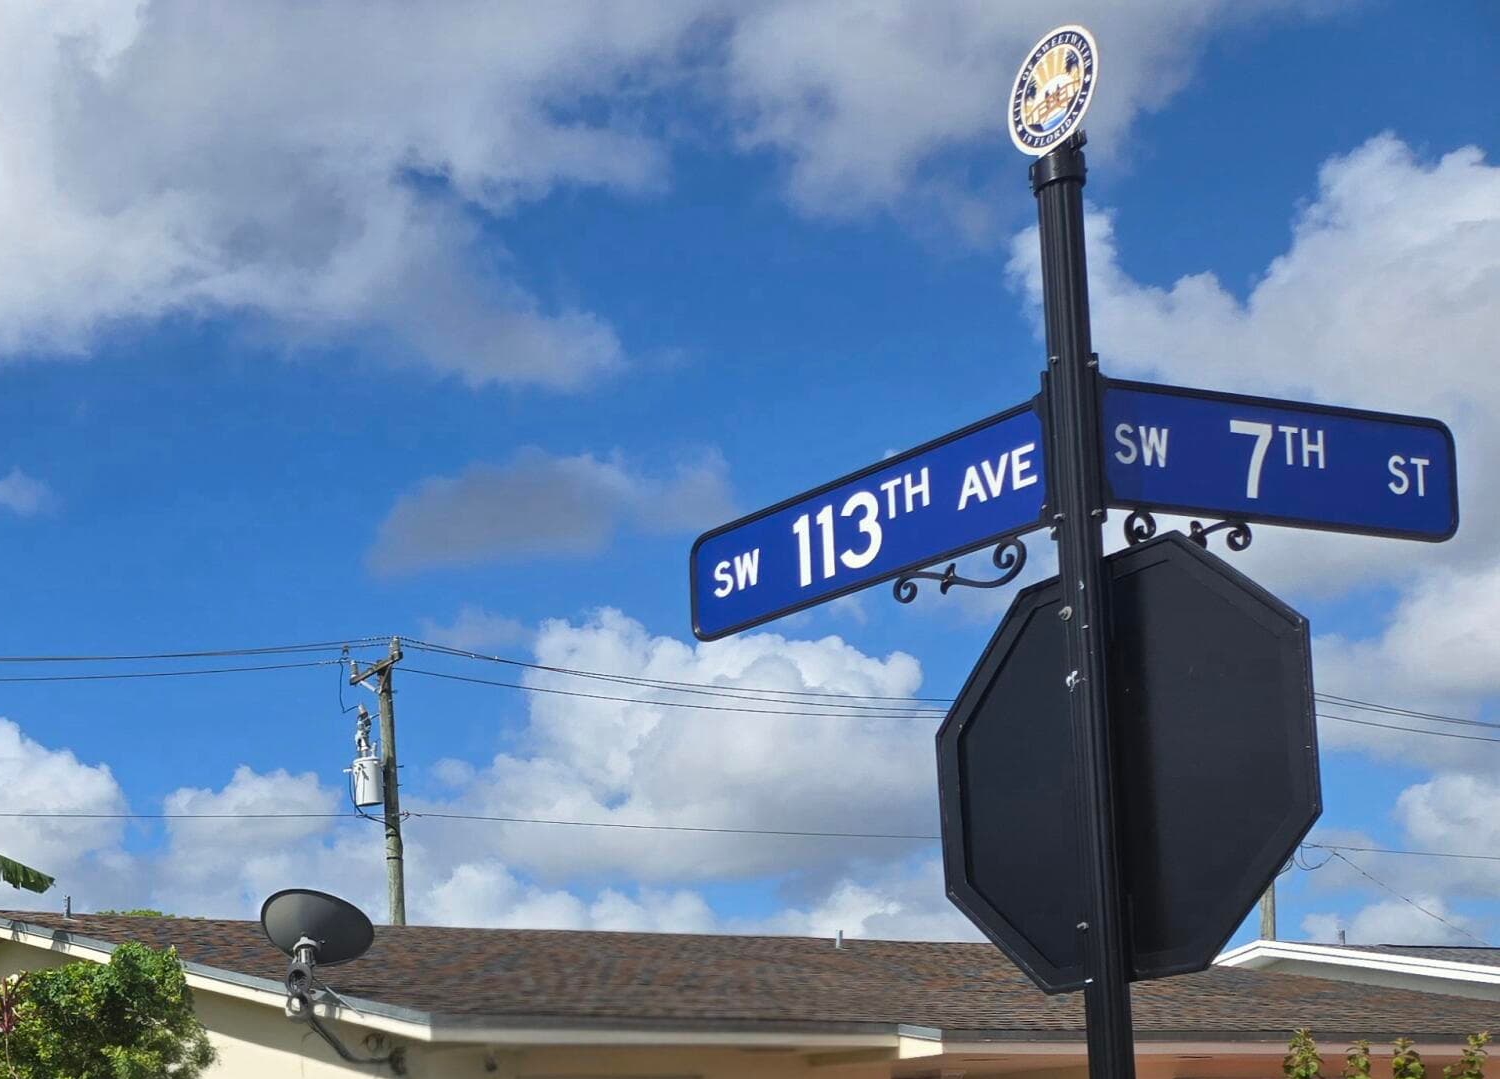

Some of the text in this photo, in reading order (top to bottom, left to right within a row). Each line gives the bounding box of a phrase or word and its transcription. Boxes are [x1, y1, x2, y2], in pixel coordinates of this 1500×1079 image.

[1033, 111, 1079, 147] FLORIDA
[1113, 419, 1430, 499] SW 7TH ST
[713, 442, 1037, 598] SW 113TH AVE
